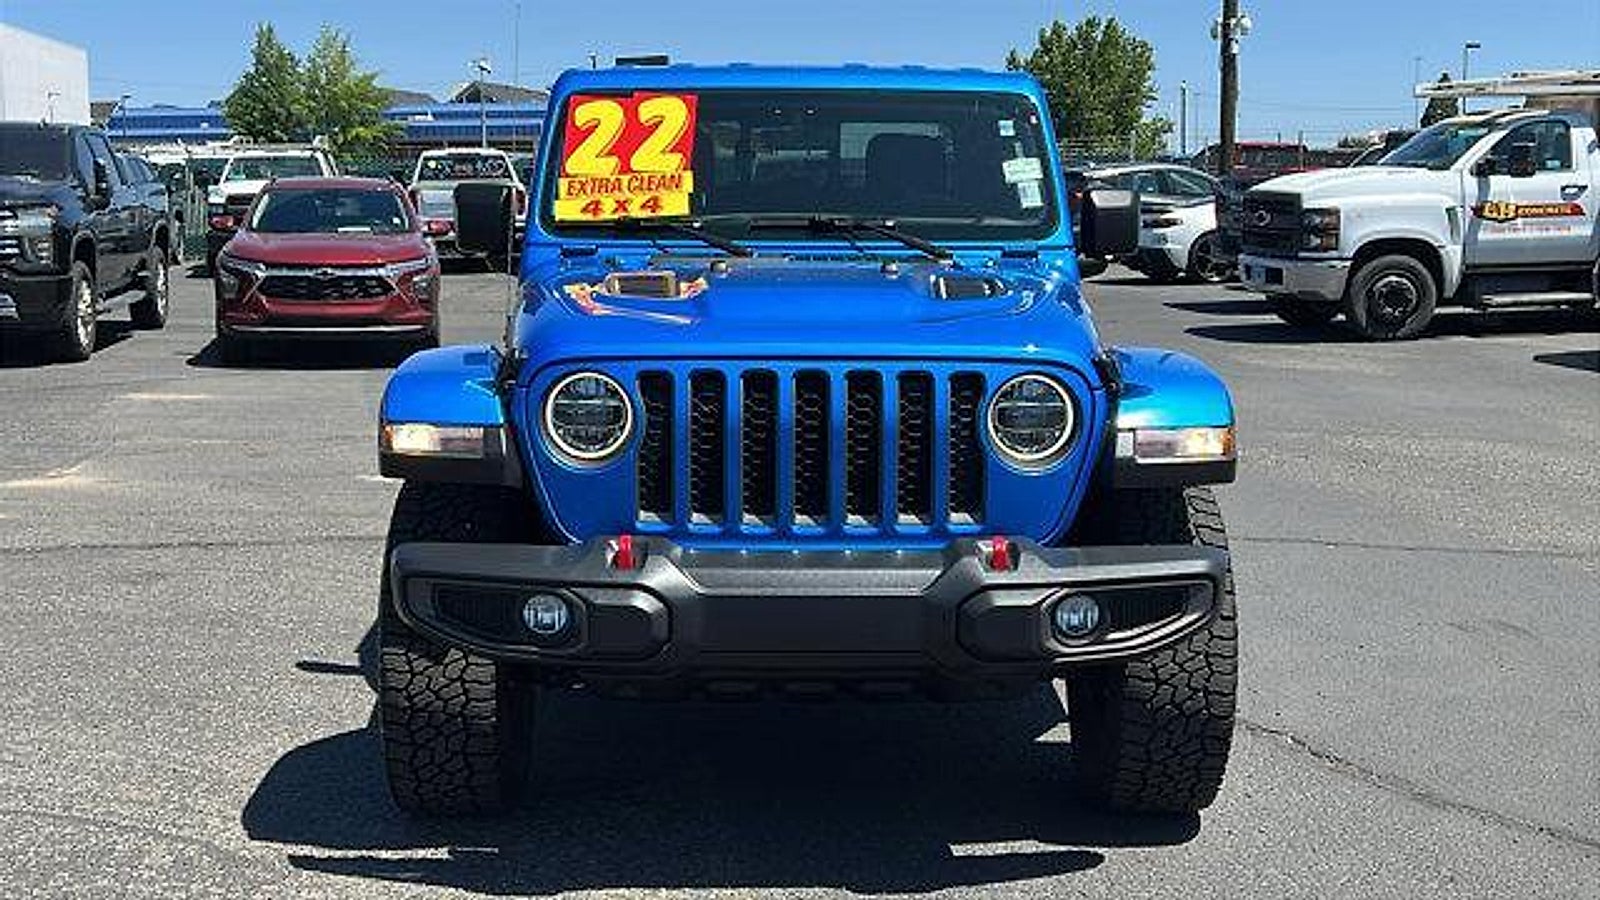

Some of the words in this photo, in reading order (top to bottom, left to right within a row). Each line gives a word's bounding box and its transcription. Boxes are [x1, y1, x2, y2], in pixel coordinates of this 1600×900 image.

[565, 96, 688, 175] 22
[567, 178, 621, 196] EXTRA
[628, 174, 682, 194] CLEAN
